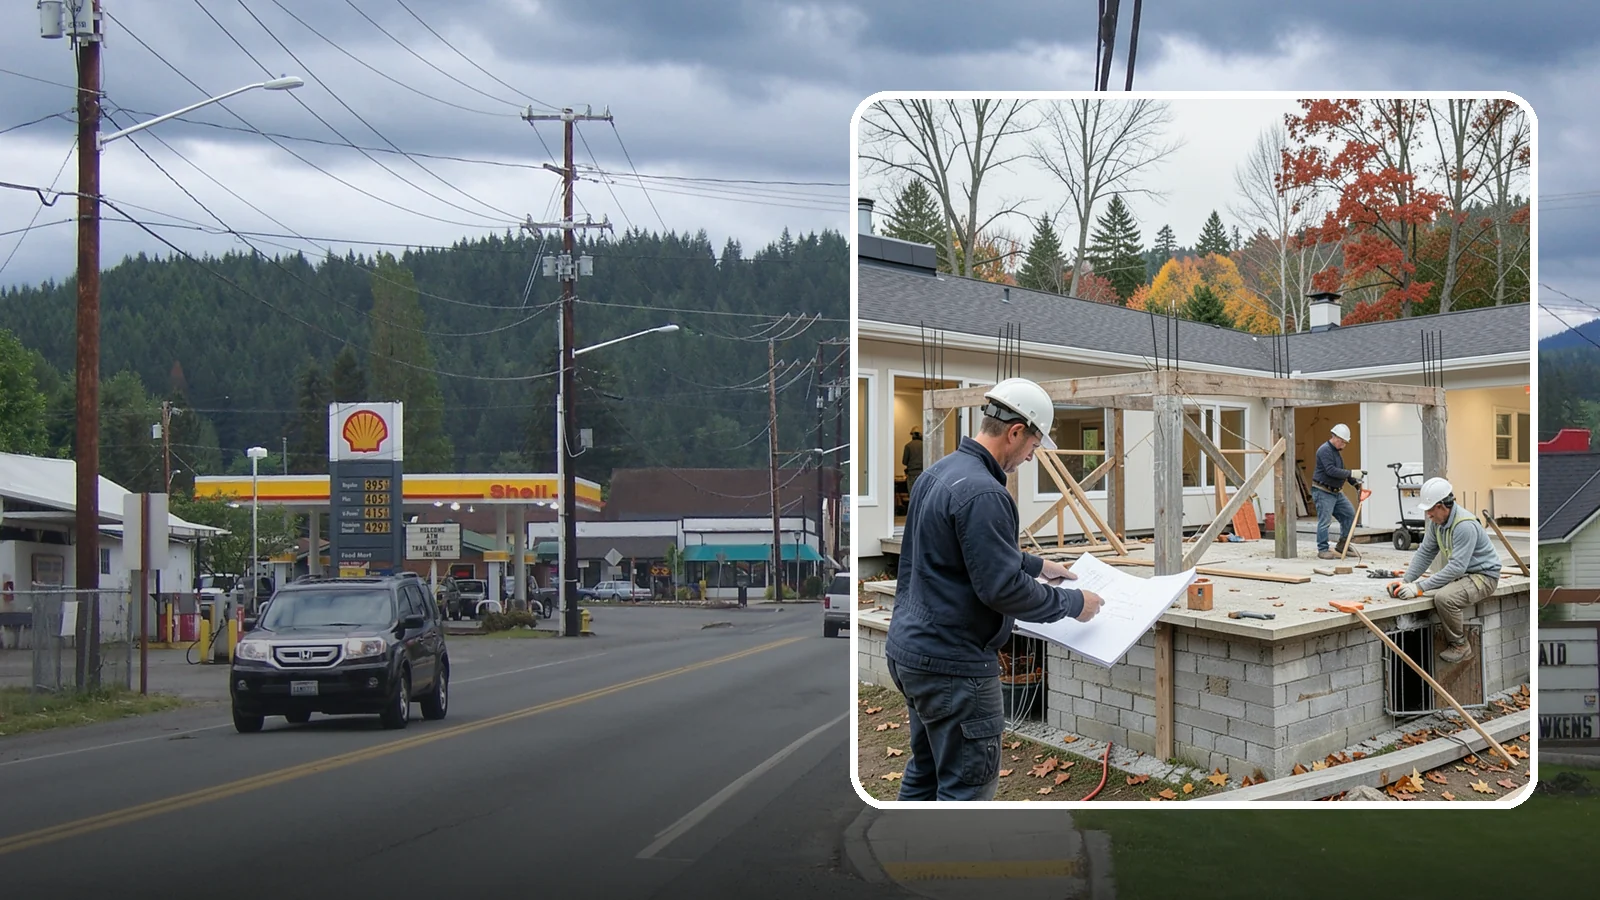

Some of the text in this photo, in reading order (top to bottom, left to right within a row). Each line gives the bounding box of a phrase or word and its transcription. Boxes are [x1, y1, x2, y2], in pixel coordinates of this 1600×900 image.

[365, 480, 383, 490] 395
[490, 484, 547, 499] Shell
[365, 494, 383, 504] 405
[365, 508, 383, 518] 415
[365, 522, 383, 532] 429
[1539, 643, 1567, 665] AID
